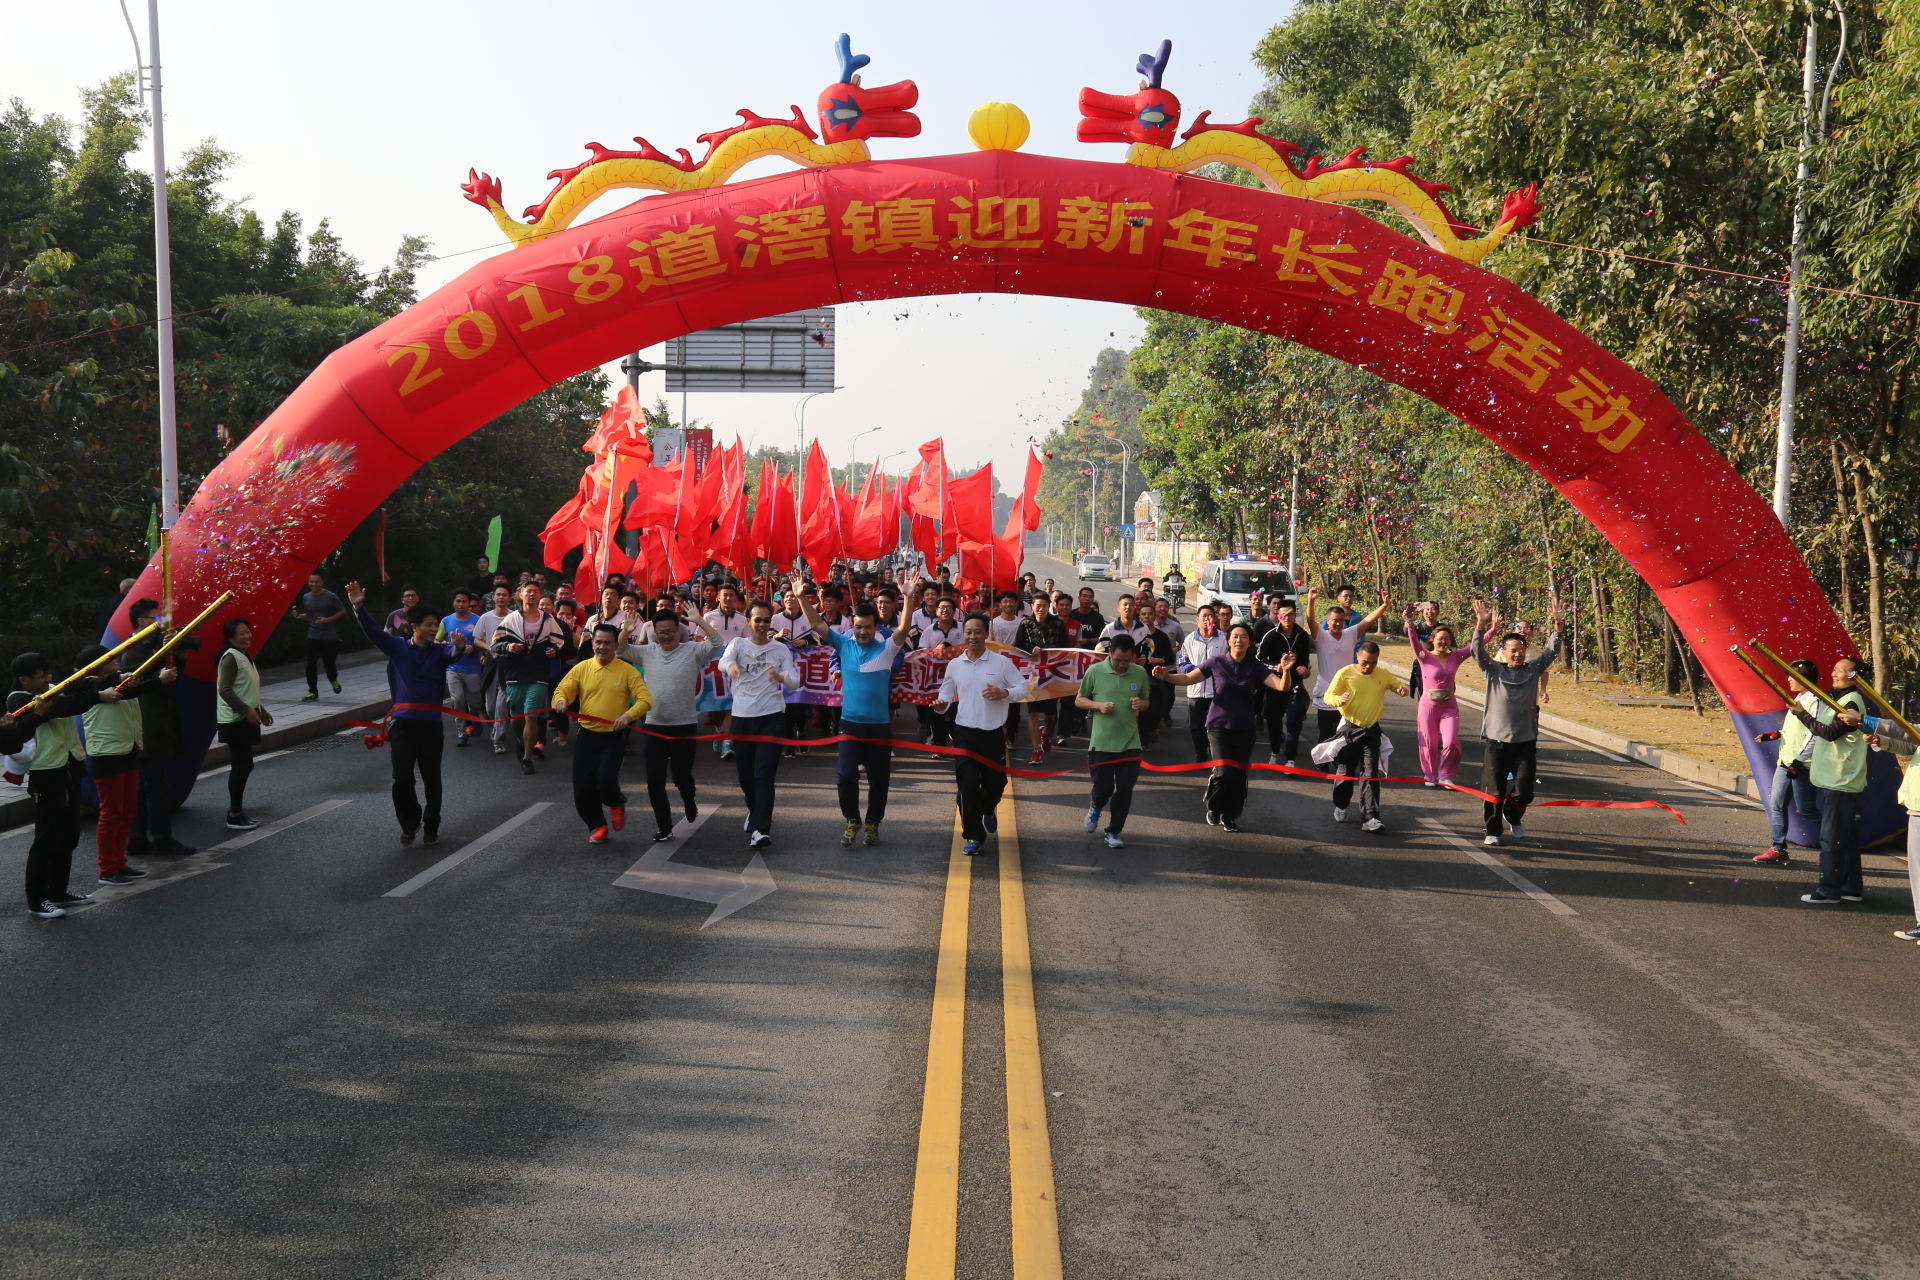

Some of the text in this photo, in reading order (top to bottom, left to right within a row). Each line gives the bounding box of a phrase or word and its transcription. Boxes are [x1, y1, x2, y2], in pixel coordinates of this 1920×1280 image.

[387, 196, 1645, 453] 2018道滘镇迎新年长跑活动
